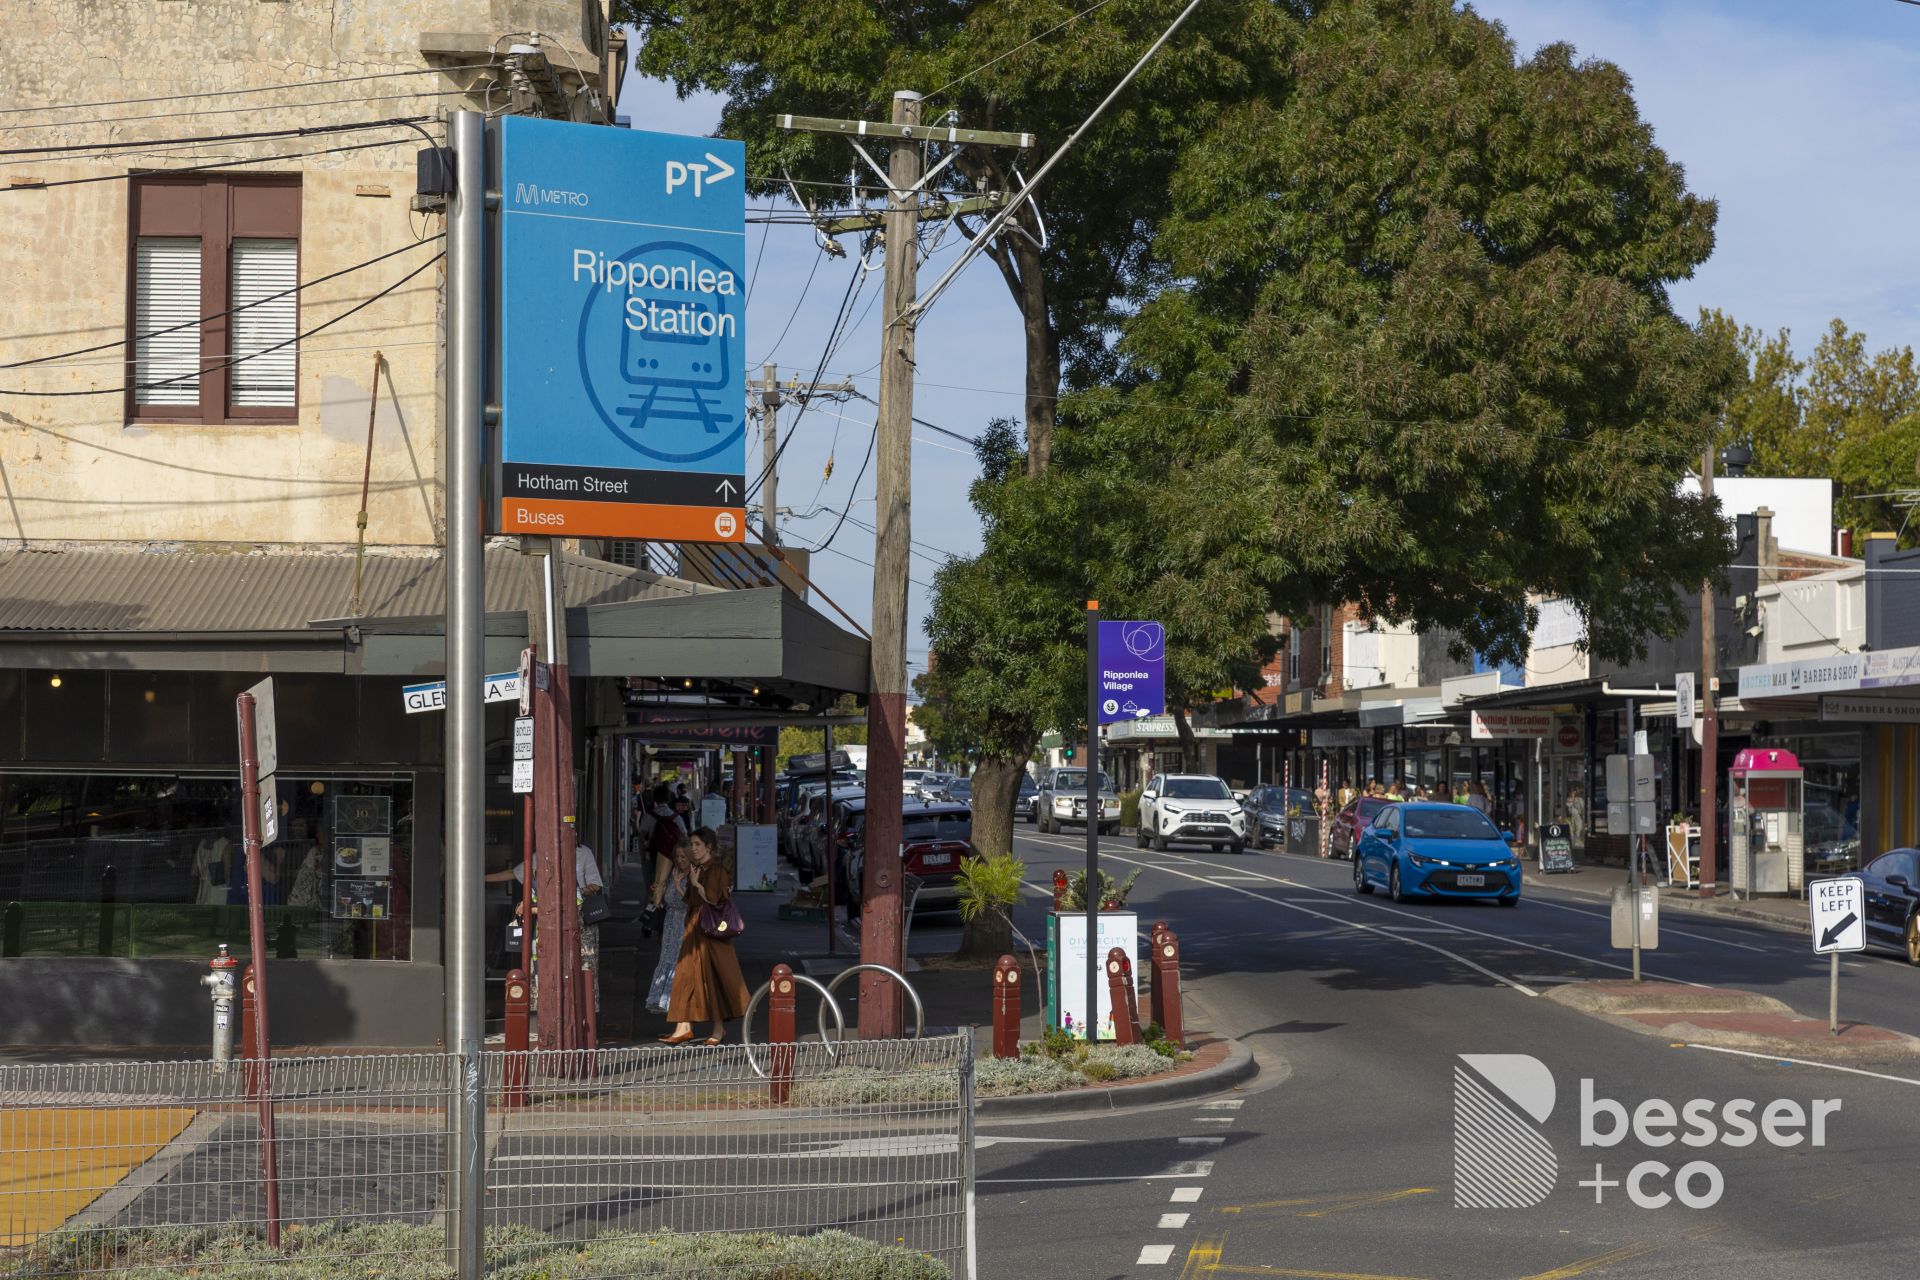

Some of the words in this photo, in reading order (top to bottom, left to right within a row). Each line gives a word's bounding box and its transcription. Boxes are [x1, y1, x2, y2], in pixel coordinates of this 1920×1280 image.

[541, 189, 589, 207] METRO
[573, 249, 736, 296] Ripponlea
[625, 297, 736, 338] Station
[518, 473, 578, 491] Hotham
[583, 476, 629, 494] Street
[517, 508, 565, 526] Buses
[1103, 670, 1148, 680] Ripponlea
[1772, 673, 1788, 686] MAN
[504, 681, 517, 691] AV
[1103, 682, 1133, 692] Village
[1476, 714, 1507, 726] Clothing
[1820, 885, 1853, 898] KEEP
[1821, 899, 1853, 912] LEFT
[1069, 937, 1128, 945] DIVRCITY
